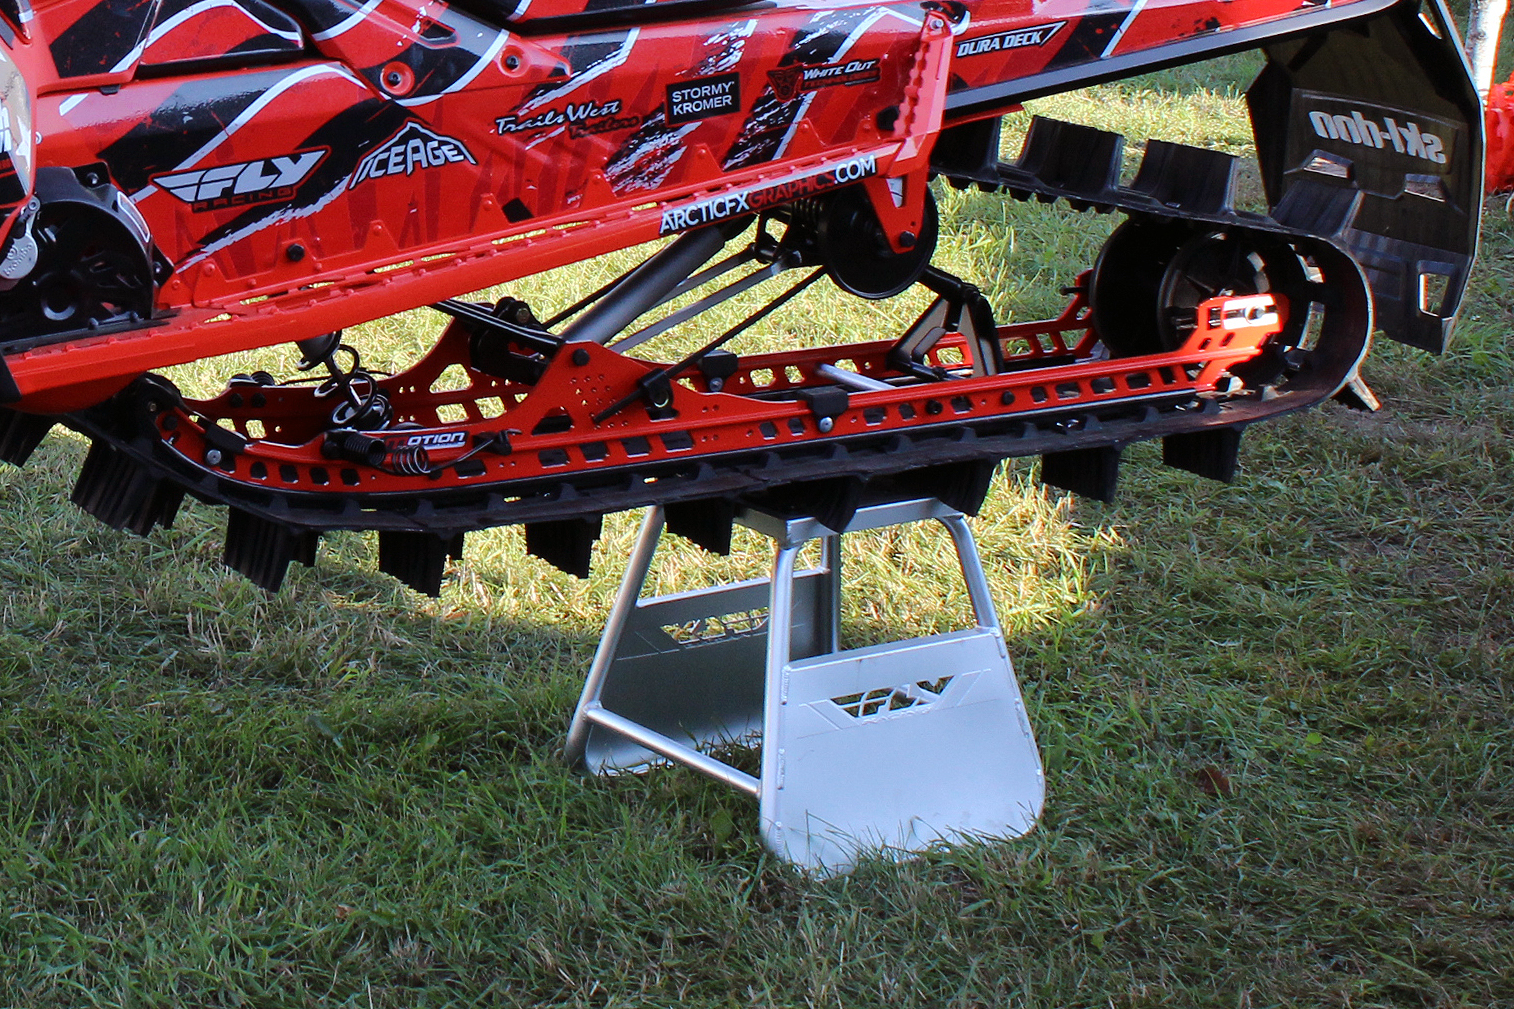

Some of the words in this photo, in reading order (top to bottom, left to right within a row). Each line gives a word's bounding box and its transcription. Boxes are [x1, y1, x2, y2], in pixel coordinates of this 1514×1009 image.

[957, 37, 1000, 58] DURA
[1004, 30, 1044, 51] DECK
[803, 65, 845, 81] WHITE
[845, 60, 877, 73] OUT
[672, 80, 733, 104] STORMY
[673, 95, 733, 118] KROMER
[161, 150, 327, 203] FLY
[193, 186, 293, 212] RACING
